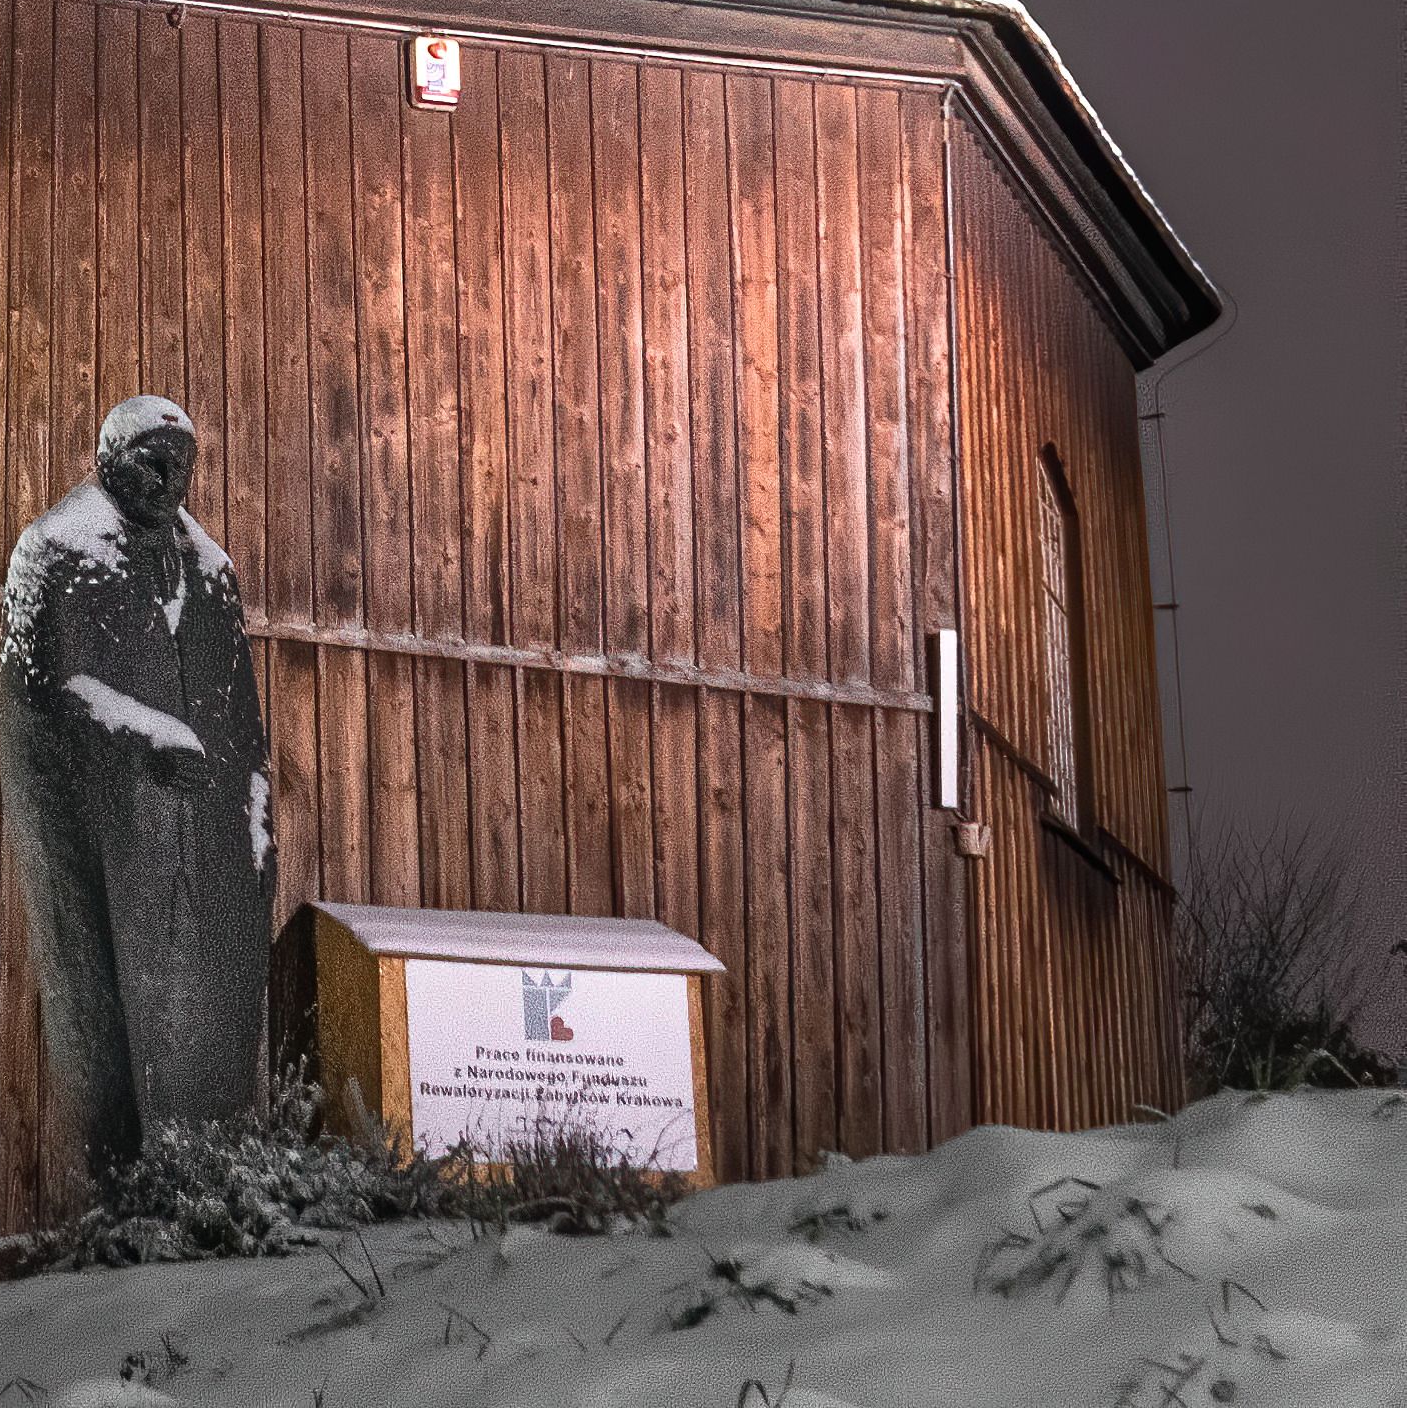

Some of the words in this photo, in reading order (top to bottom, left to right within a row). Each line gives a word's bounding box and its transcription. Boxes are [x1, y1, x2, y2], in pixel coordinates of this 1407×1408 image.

[526, 1048, 624, 1066] finansowane
[467, 1065, 566, 1085] Narodowego
[420, 1081, 530, 1103] Rewaloryzacji
[615, 1091, 683, 1107] Krakowa
